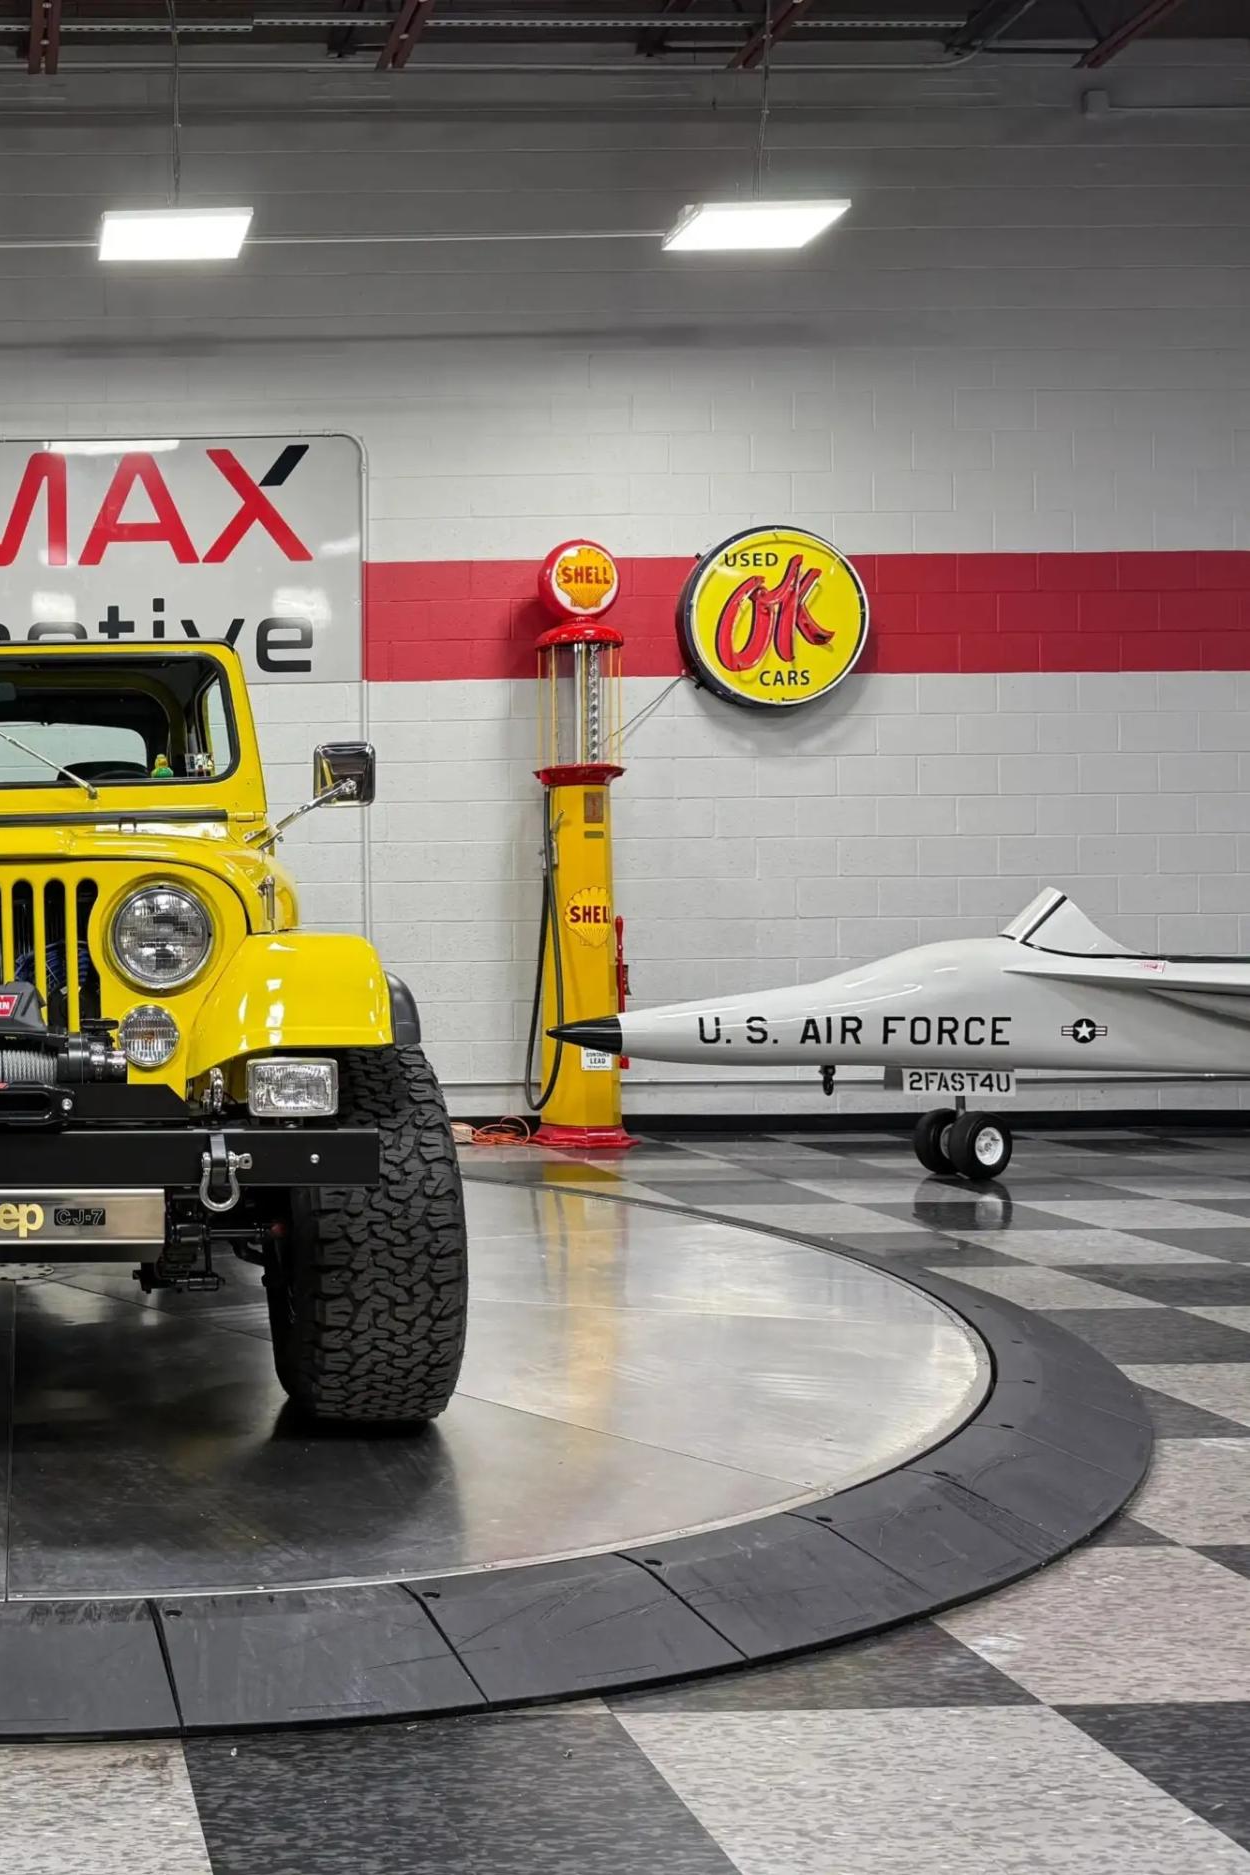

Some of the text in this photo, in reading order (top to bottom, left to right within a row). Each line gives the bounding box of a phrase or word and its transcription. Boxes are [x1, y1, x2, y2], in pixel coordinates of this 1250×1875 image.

[724, 553, 779, 567] USED
[561, 566, 611, 585] SHELL
[716, 554, 835, 672] OK
[759, 670, 811, 687] CARS
[698, 1016, 1012, 1046] U. S. AIR FORCE
[908, 1071, 1011, 1092] 2FAST4U
[56, 1209, 103, 1225] CJ-7
